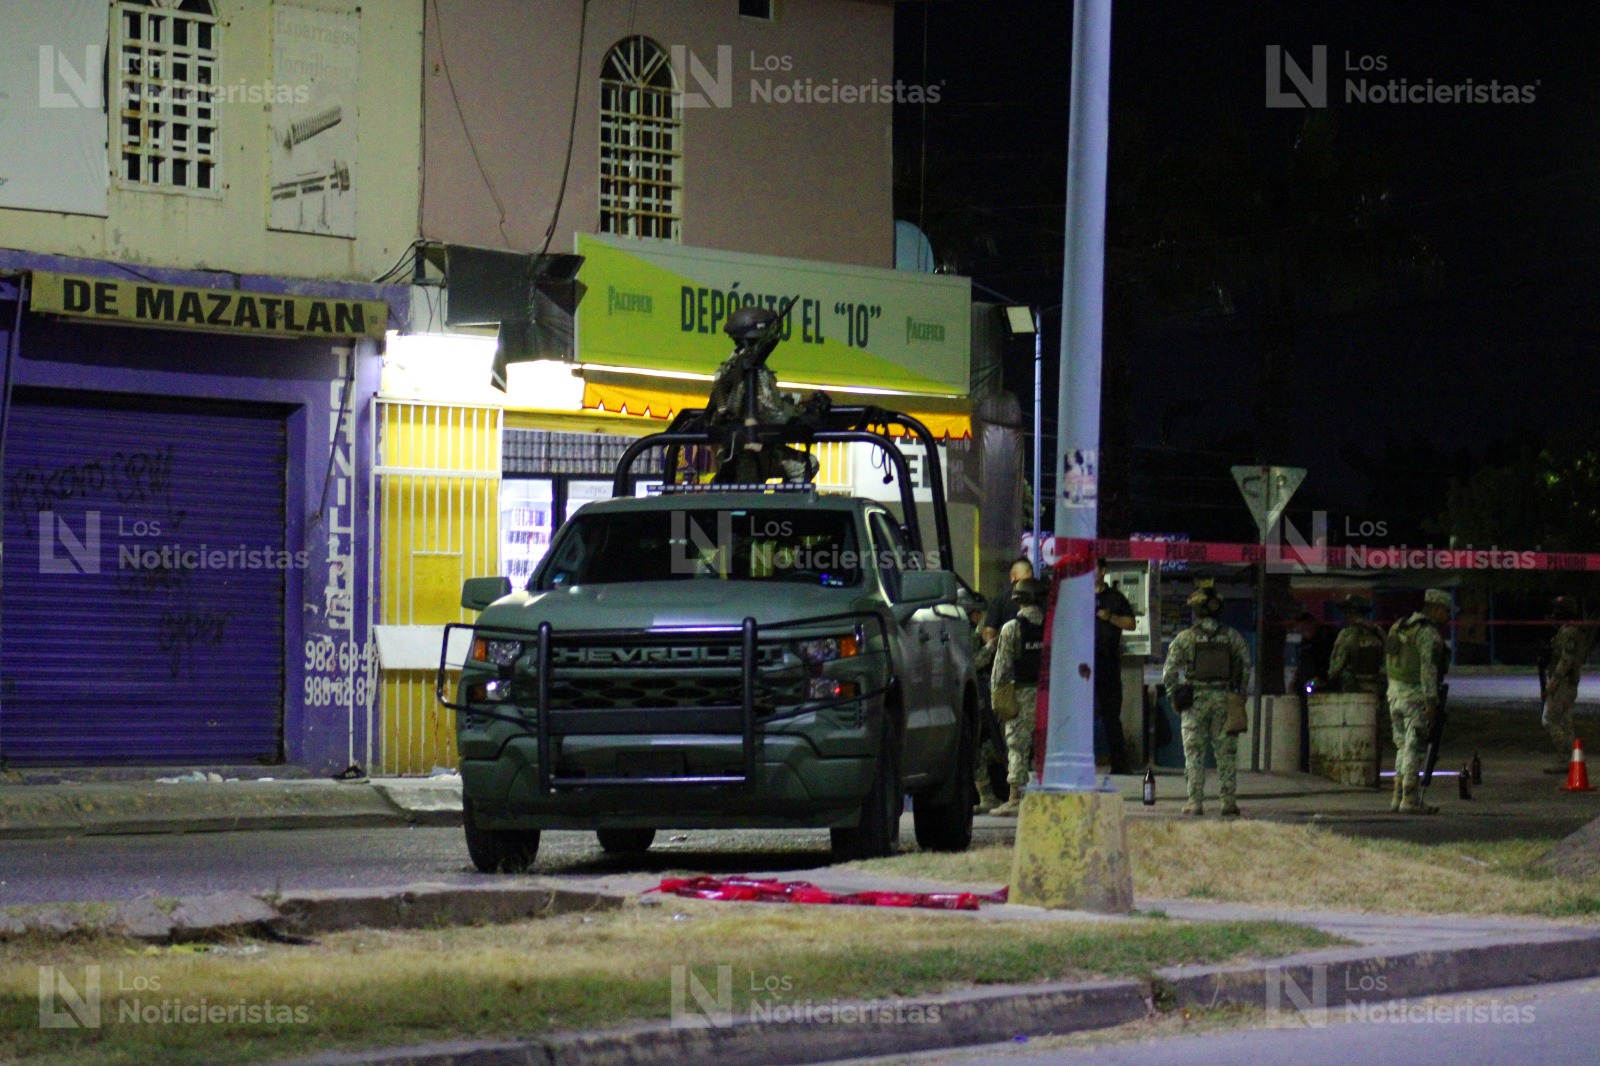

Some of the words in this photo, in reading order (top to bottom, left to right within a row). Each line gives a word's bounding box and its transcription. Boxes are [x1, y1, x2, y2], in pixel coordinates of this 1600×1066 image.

[63, 278, 119, 314] DE
[136, 286, 366, 333] MAZATLAN
[802, 298, 825, 345] EL
